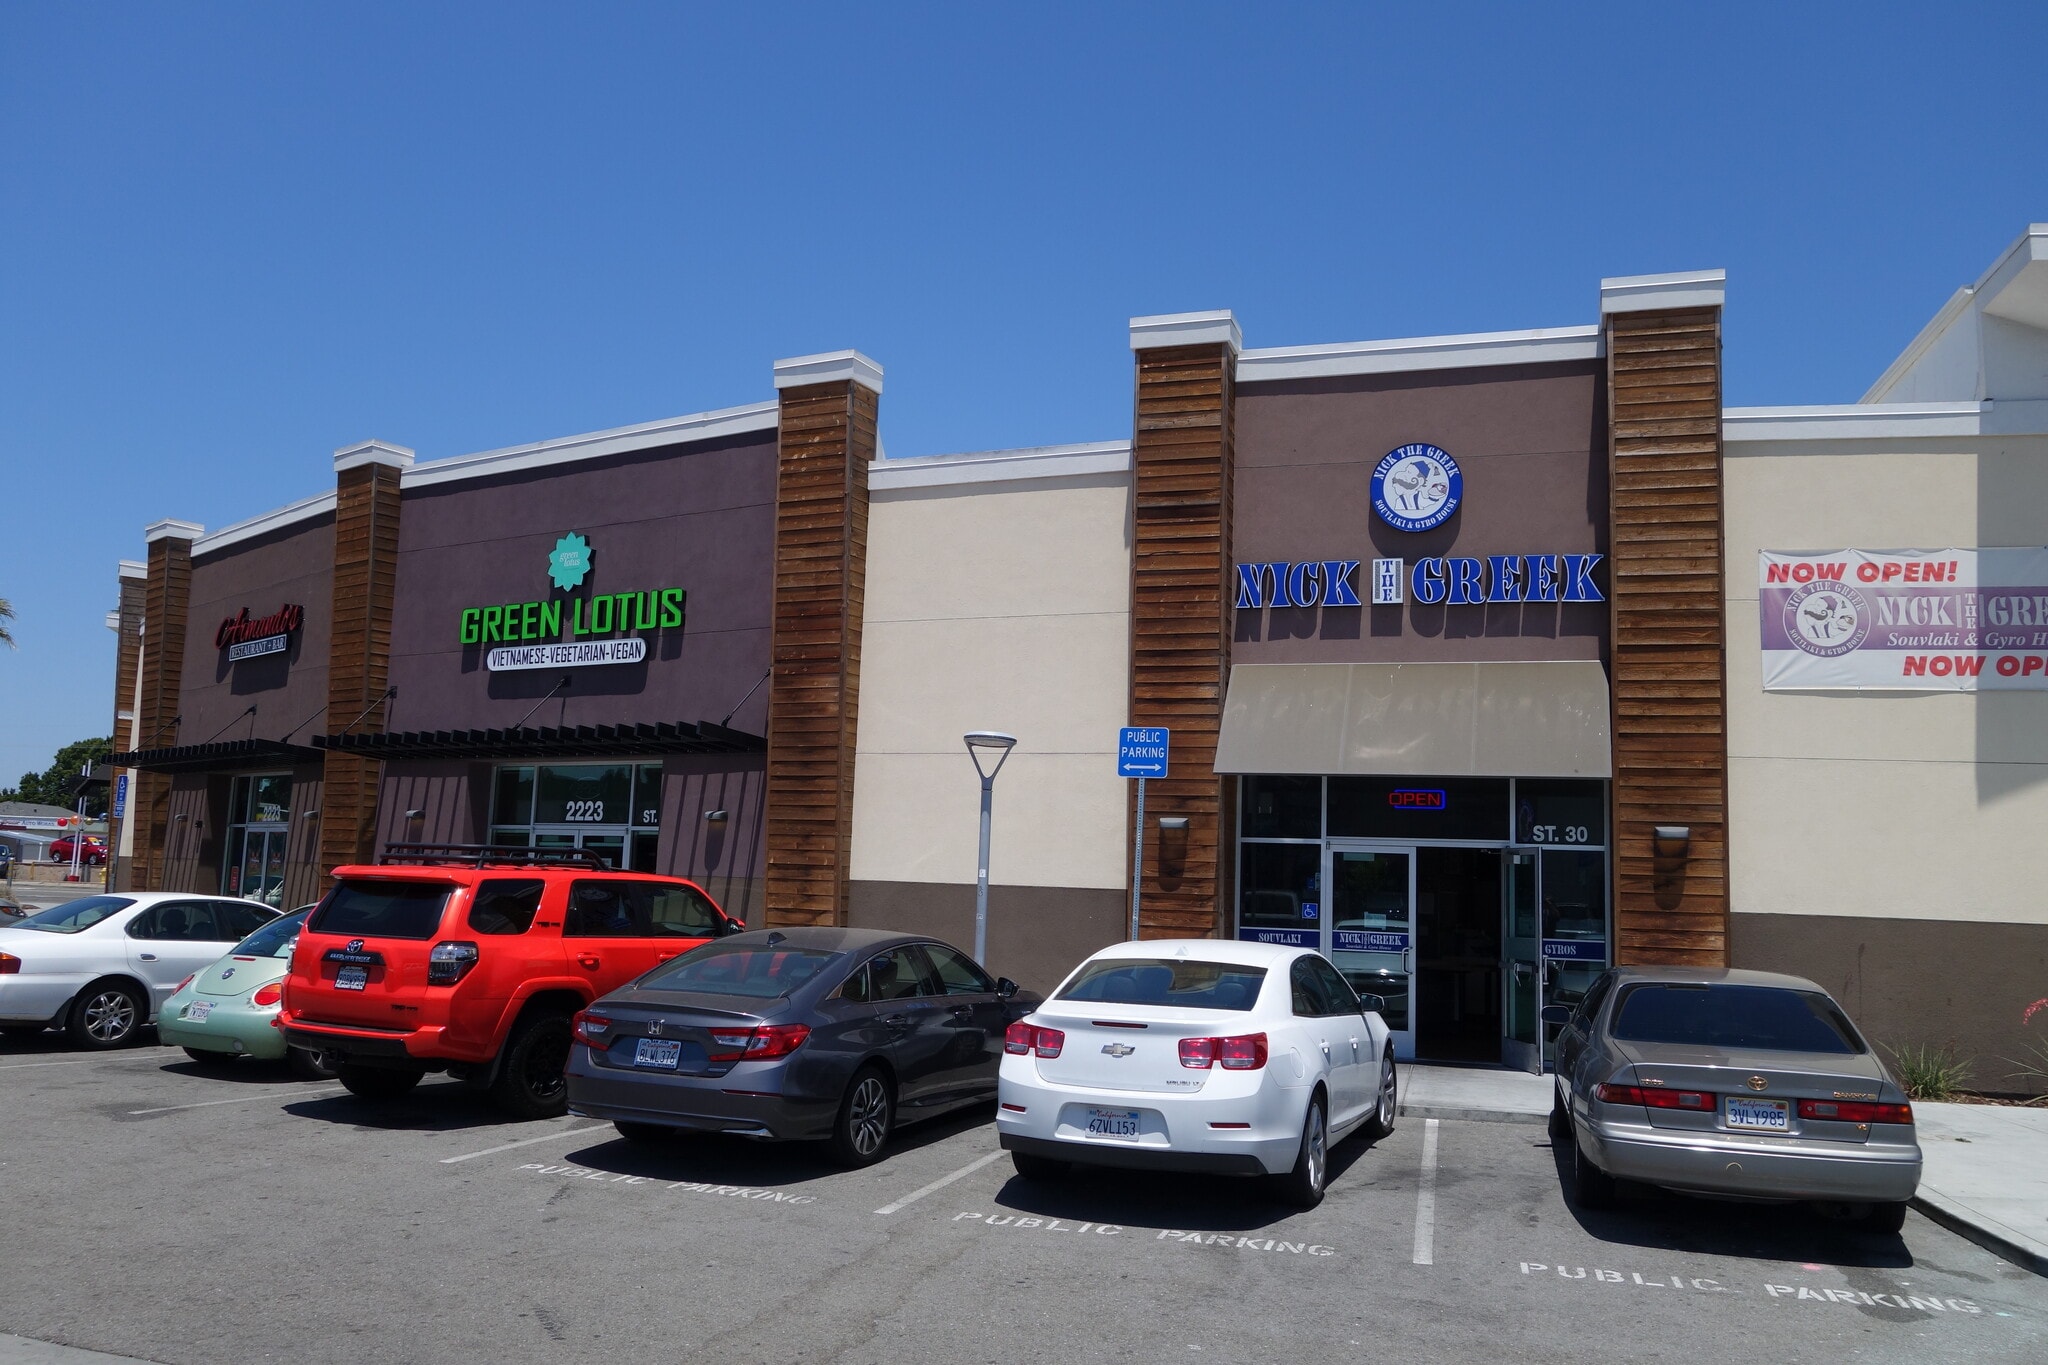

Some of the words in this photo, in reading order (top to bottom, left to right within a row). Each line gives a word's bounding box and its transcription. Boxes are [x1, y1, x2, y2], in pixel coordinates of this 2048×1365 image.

[1373, 453, 1398, 480] NICK
[1397, 445, 1423, 458] THE
[1427, 446, 1460, 478] GREEK
[1375, 499, 1406, 527] SOUVLAKI
[1415, 517, 1436, 528] GYRO
[1436, 498, 1457, 521] HOUSE
[560, 551, 578, 562] green
[564, 557, 580, 566] lotus
[1766, 563, 1847, 583] NOW
[1856, 561, 1958, 582] OPEN!
[1235, 560, 1362, 608] NICK
[1382, 561, 1393, 601] THE
[1411, 554, 1605, 605] GREEK
[1787, 590, 1808, 612] NICK
[1807, 581, 1831, 593] THE
[1835, 583, 1866, 611] GREEK
[460, 600, 561, 644] GREEN
[573, 588, 683, 635] LOTUS
[1876, 596, 1954, 626] NICK
[1965, 593, 1977, 629] THE
[231, 641, 267, 658] RESTAURANT
[272, 638, 285, 650] BAR
[1789, 628, 1819, 654] SOUVLAKI
[1827, 645, 1847, 655] GYRO
[1846, 628, 1866, 649] HOUSE
[1887, 632, 1960, 646] Souvlaki
[1964, 632, 1978, 646] &
[1985, 632, 2026, 649] Gyro
[1903, 655, 1986, 677] NOW
[1996, 655, 2048, 677] OP
[1127, 732, 1160, 742] PUBLIC
[1121, 747, 1165, 758] PARKING
[1389, 792, 1440, 806] OPEN
[565, 801, 604, 821] 2223
[643, 810, 657, 823] ST.
[1532, 825, 1559, 842] ST.
[1565, 826, 1588, 842] 30
[1258, 932, 1301, 944] SOUVLAKI
[1340, 933, 1361, 943] NICK
[1370, 935, 1402, 945] GREEK
[1545, 944, 1577, 955] GYROS
[639, 1049, 676, 1063] 8LWL376
[1738, 1100, 1774, 1109] California
[1097, 1110, 1127, 1119] California
[1731, 1108, 1785, 1126] 3VLY985
[1089, 1118, 1136, 1135] 6ZVL153
[516, 1163, 655, 1185] PUBLIC
[666, 1180, 818, 1204] PARKING
[951, 1211, 1123, 1235] PUBLIC
[1156, 1228, 1336, 1256] PARKING
[1519, 1262, 1727, 1291] PUBLIC
[1763, 1283, 1981, 1314] PARKING
